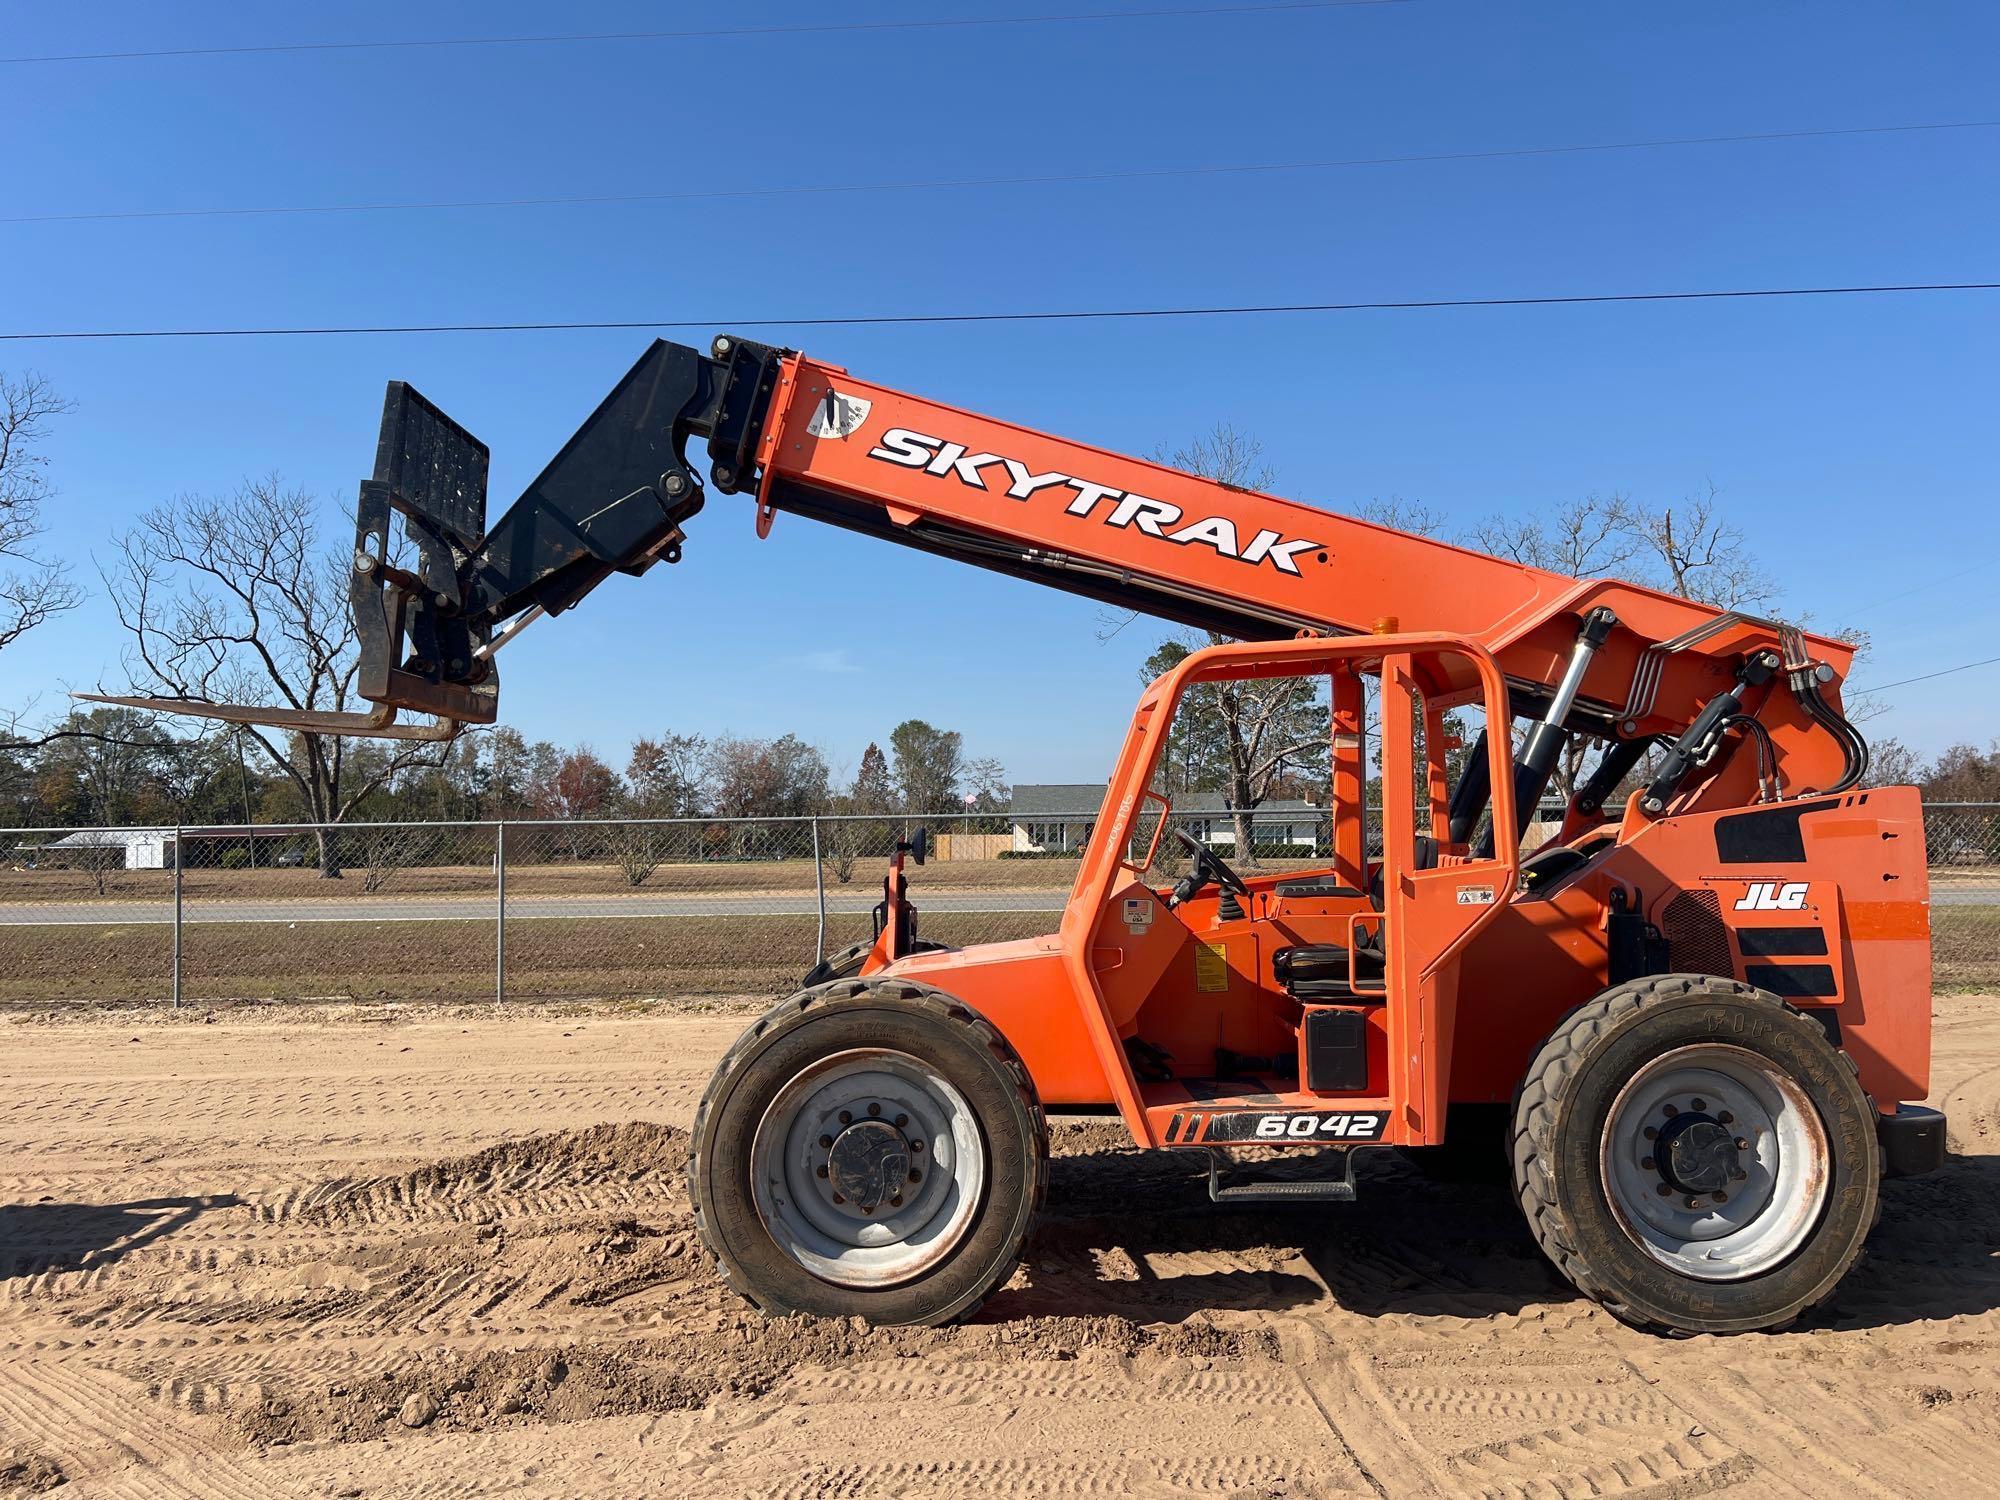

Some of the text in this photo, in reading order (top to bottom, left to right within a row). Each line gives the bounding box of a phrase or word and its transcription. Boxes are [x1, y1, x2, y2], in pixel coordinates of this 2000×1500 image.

[866, 427, 1328, 577] SKYTRAK
[1734, 882, 1810, 910] JLG
[1255, 1115, 1379, 1137] 6042
